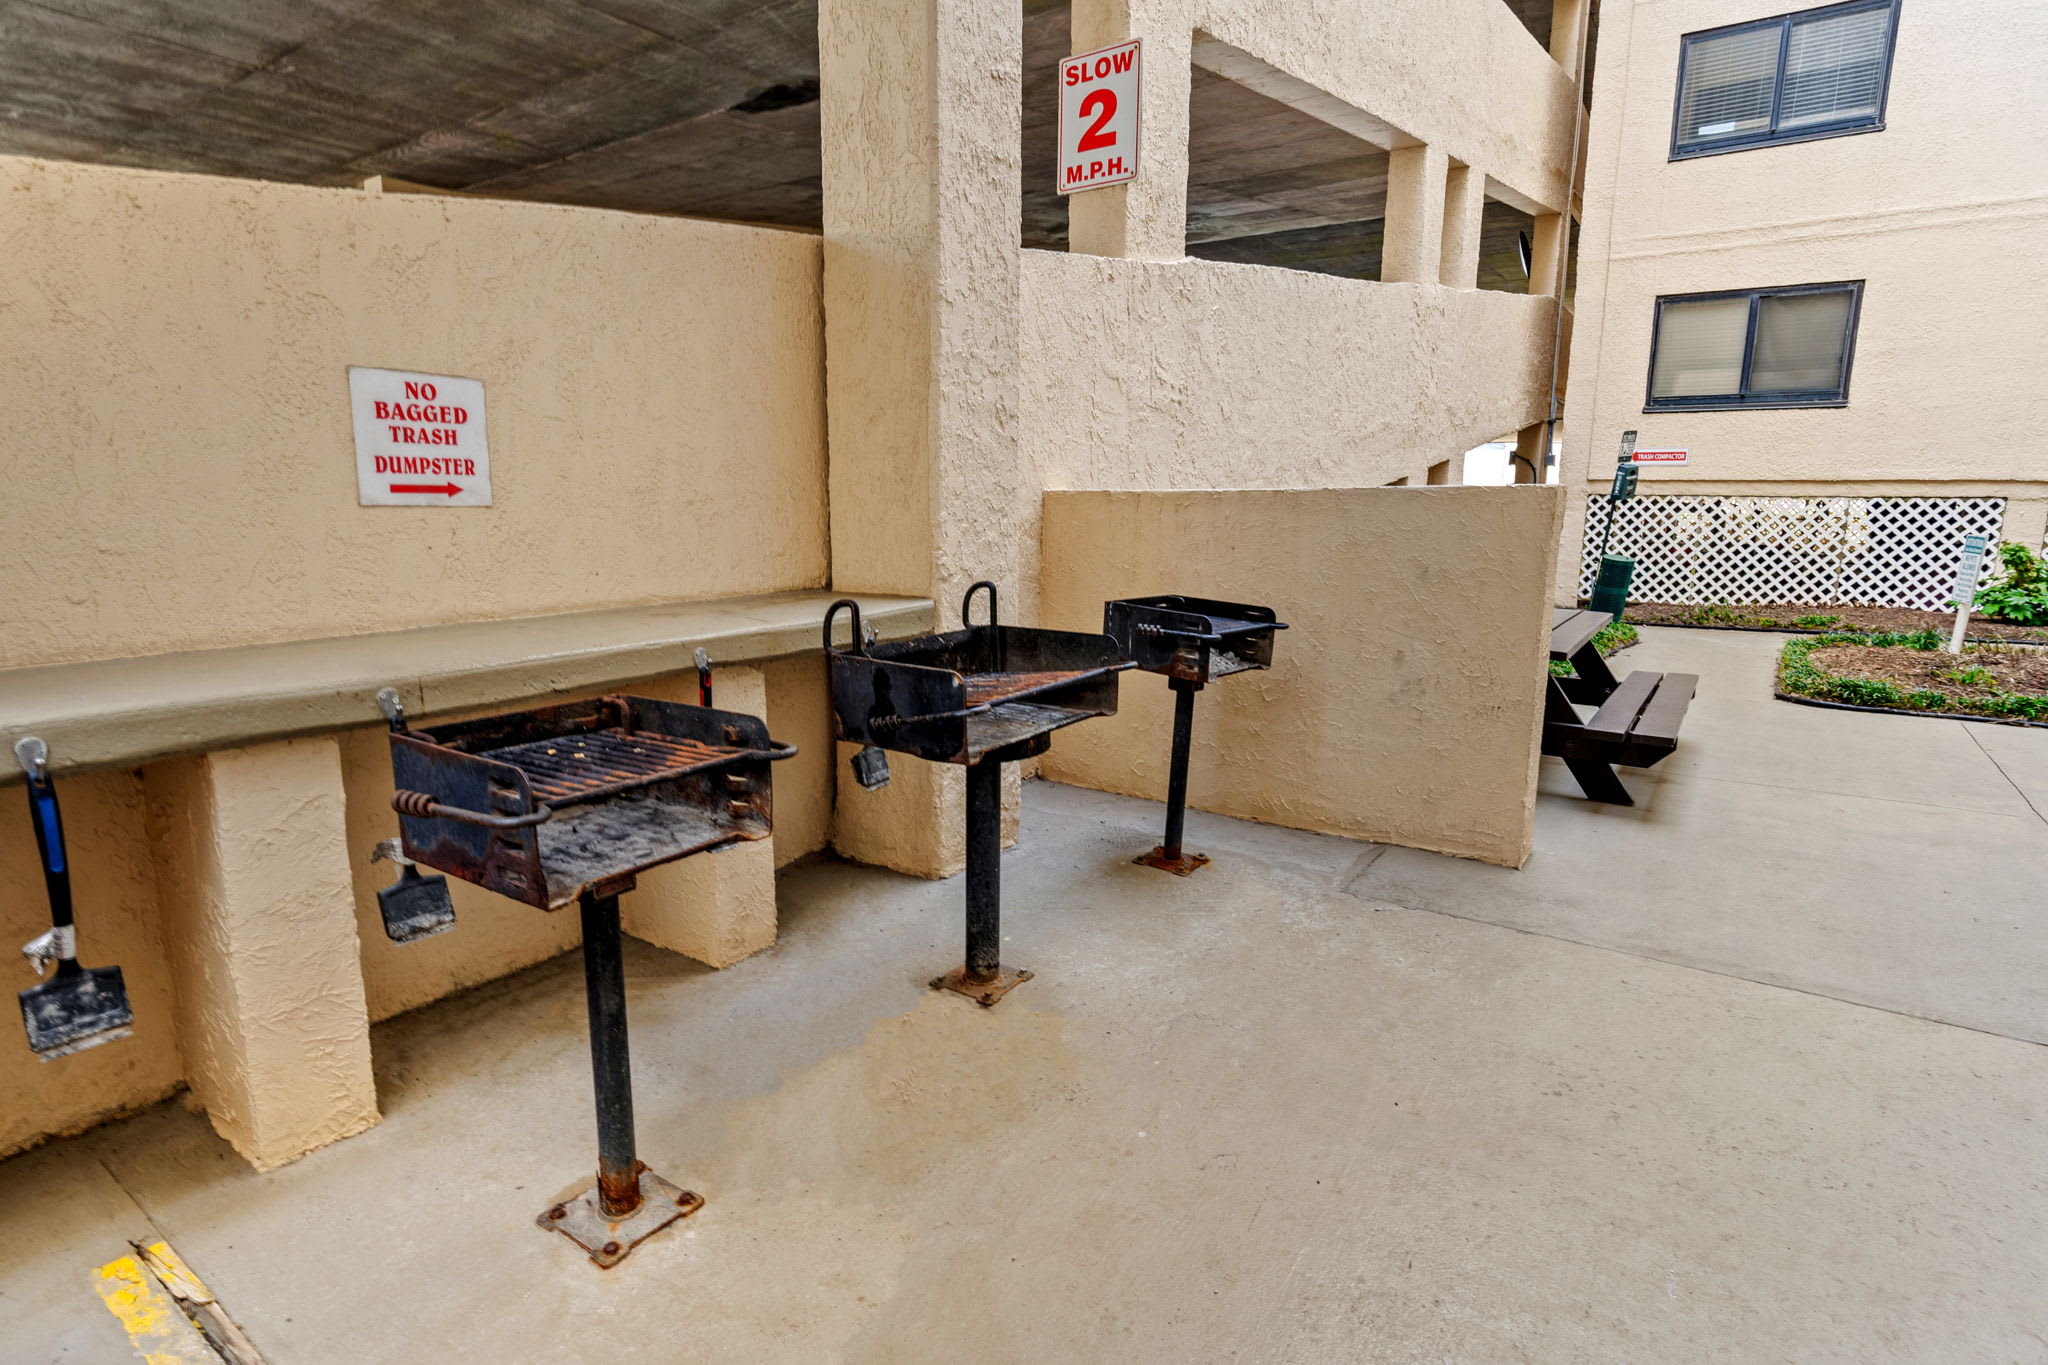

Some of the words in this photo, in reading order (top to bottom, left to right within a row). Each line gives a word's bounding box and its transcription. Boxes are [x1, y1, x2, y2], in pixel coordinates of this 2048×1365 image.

[1066, 50, 1134, 87] SLOW
[1077, 88, 1118, 153] 2
[1066, 156, 1129, 185] M.P.H.
[404, 381, 437, 401] NO
[374, 401, 468, 424] BAGGED
[388, 425, 459, 446] TRASH
[374, 455, 476, 476] DUMPSTER
